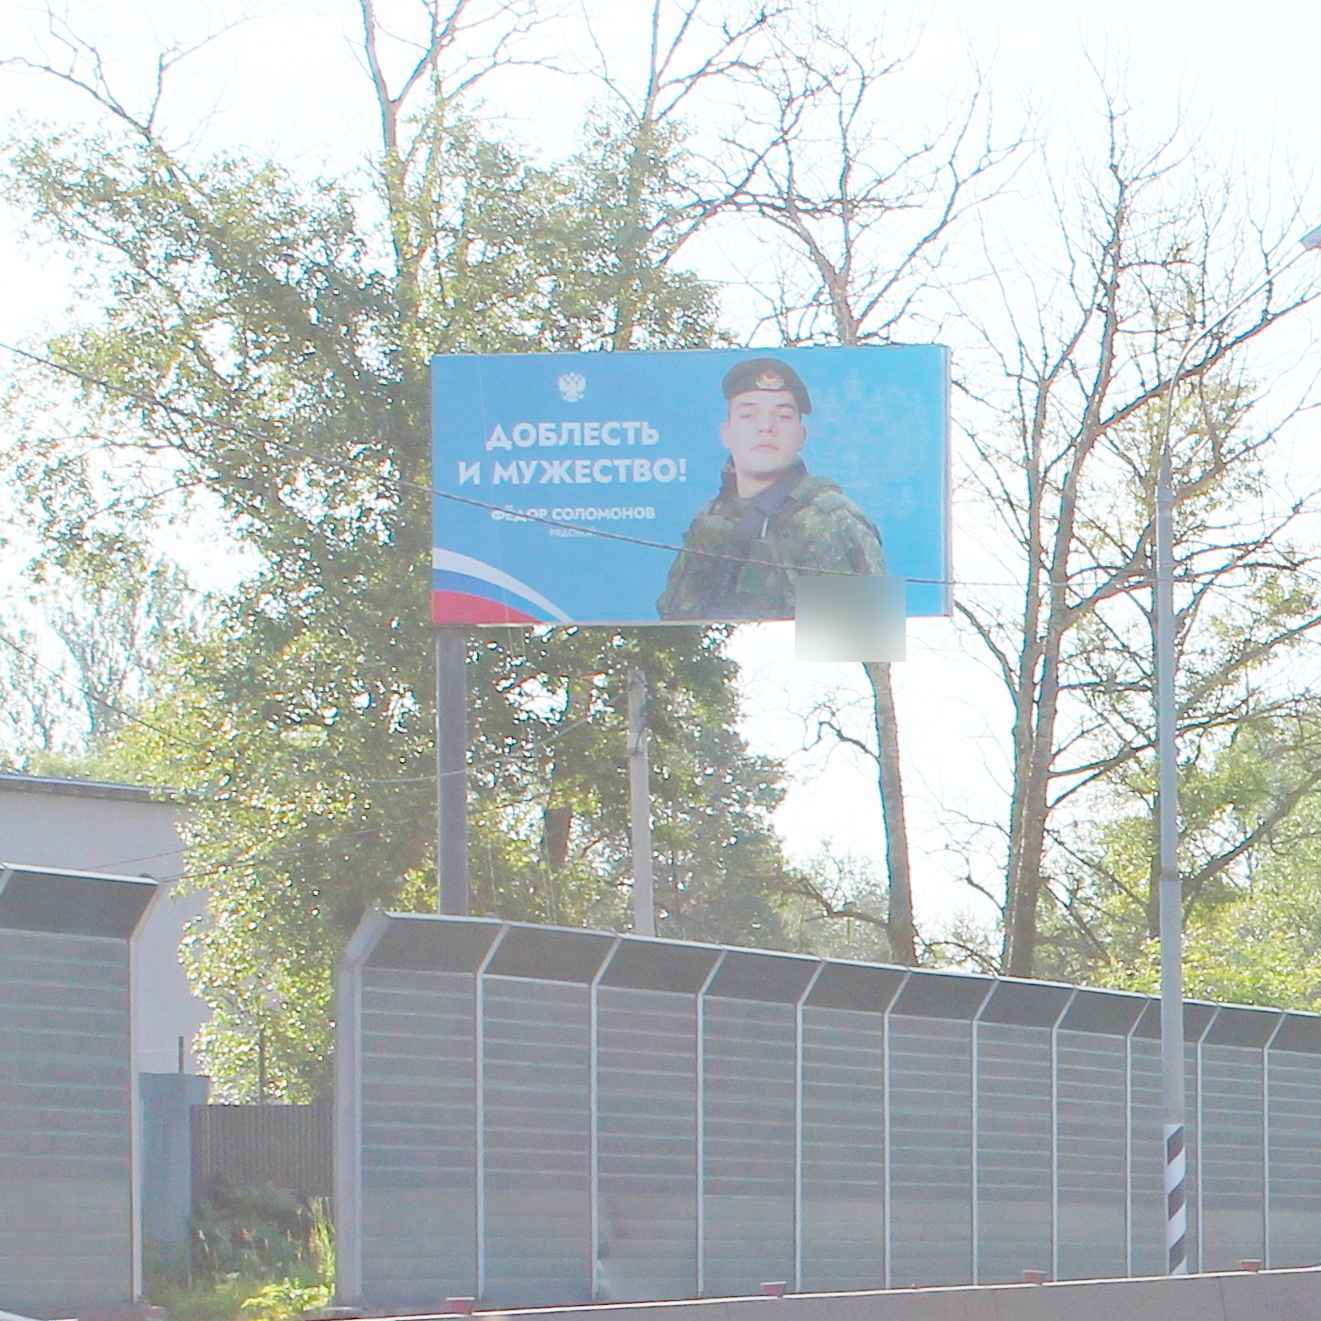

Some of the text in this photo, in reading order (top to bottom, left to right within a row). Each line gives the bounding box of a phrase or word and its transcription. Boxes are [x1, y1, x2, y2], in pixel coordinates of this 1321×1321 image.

[485, 421, 660, 451] ДОБЛЕСТЬ
[457, 457, 688, 486] И МУЖЕСТВО!
[551, 506, 656, 521] СОЛОМОНОВ
